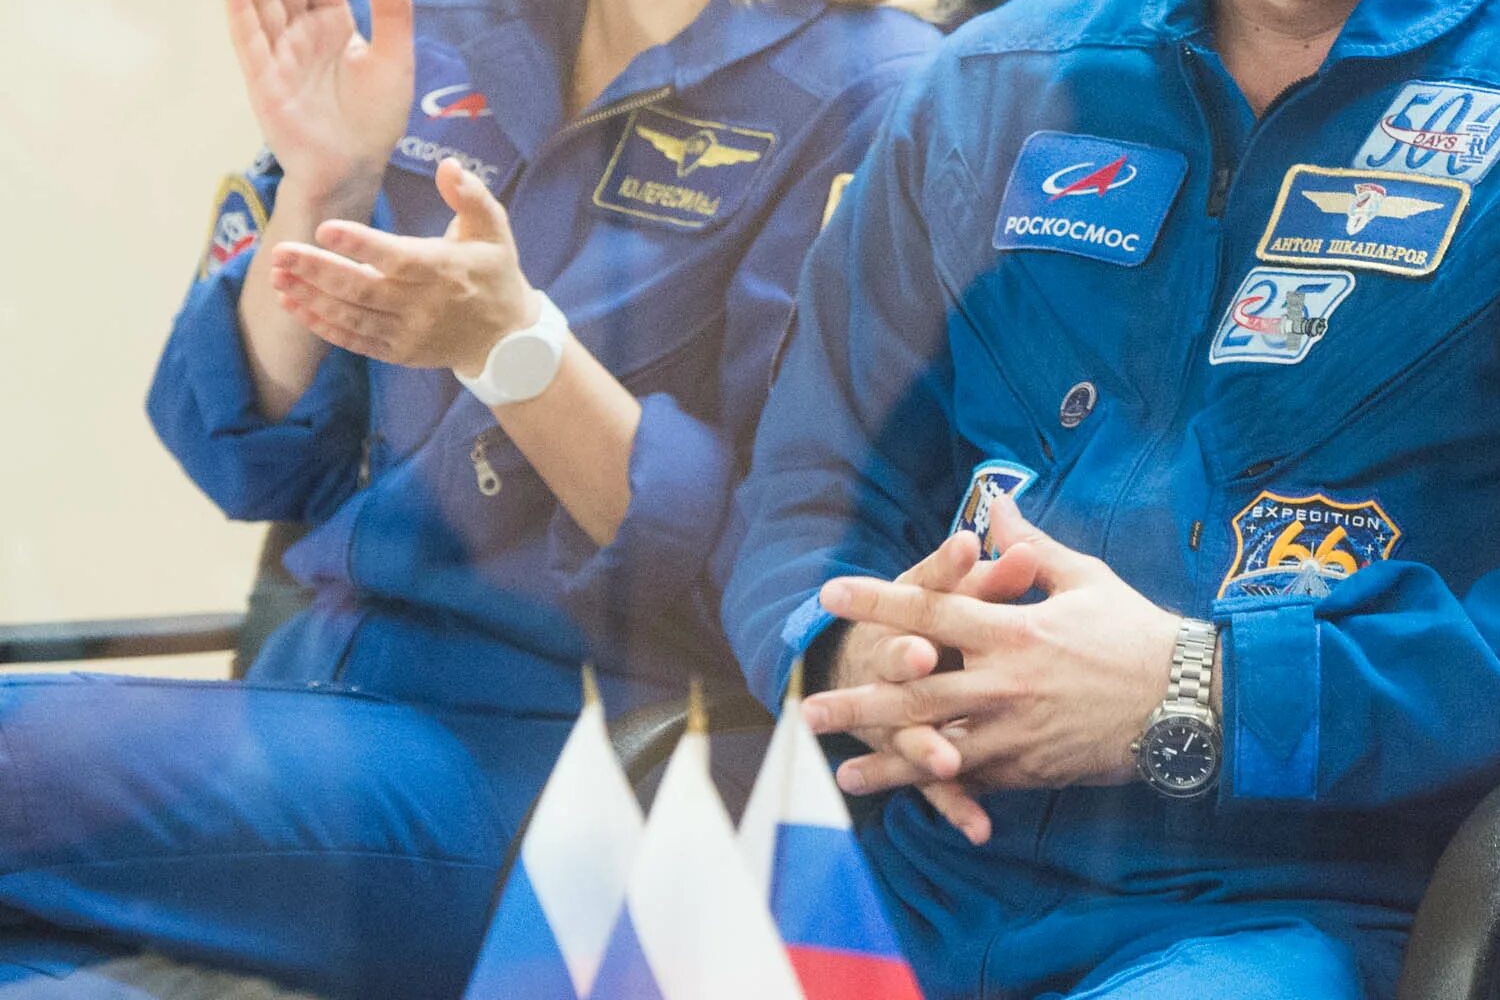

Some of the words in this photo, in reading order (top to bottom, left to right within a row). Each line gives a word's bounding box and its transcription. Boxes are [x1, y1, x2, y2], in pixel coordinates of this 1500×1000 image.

[1412, 132, 1459, 151] DAYS
[1003, 215, 1140, 252] РОСКОСМОС
[1271, 237, 1324, 254] АНТОН
[1326, 239, 1429, 266] ШКАПЛЕРОВ
[1251, 505, 1381, 531] EXPEDITION
